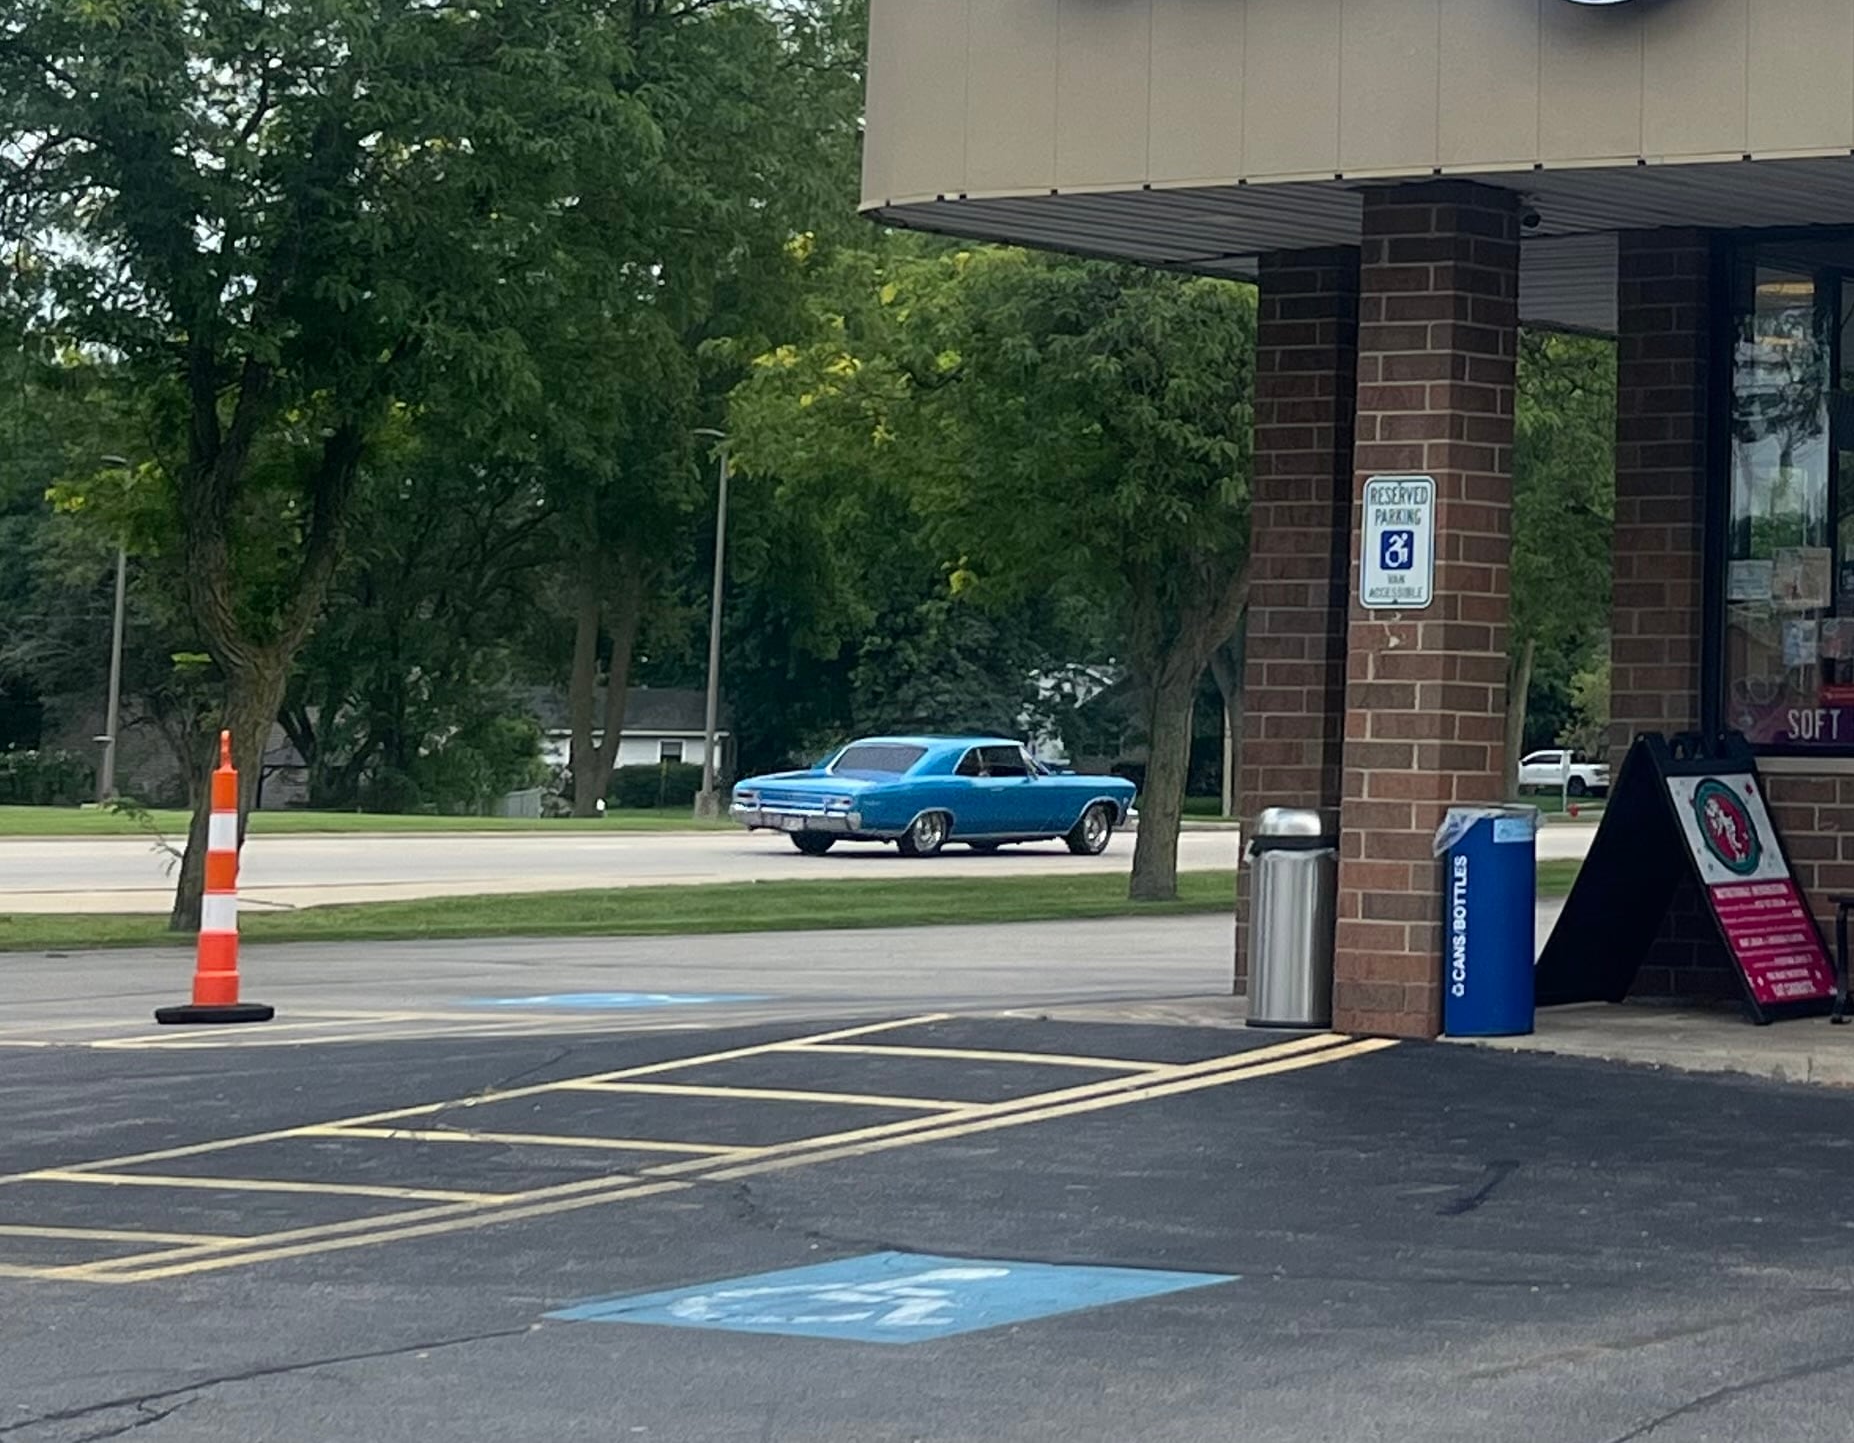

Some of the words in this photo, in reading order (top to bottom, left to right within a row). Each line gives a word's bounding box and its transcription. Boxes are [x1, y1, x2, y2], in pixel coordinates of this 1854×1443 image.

[1370, 486, 1428, 505] RESERVED
[1374, 508, 1421, 526] PARKING
[1387, 574, 1405, 584] VAN
[1369, 586, 1423, 599] ACCESSIBLE
[1787, 709, 1841, 742] SOFT
